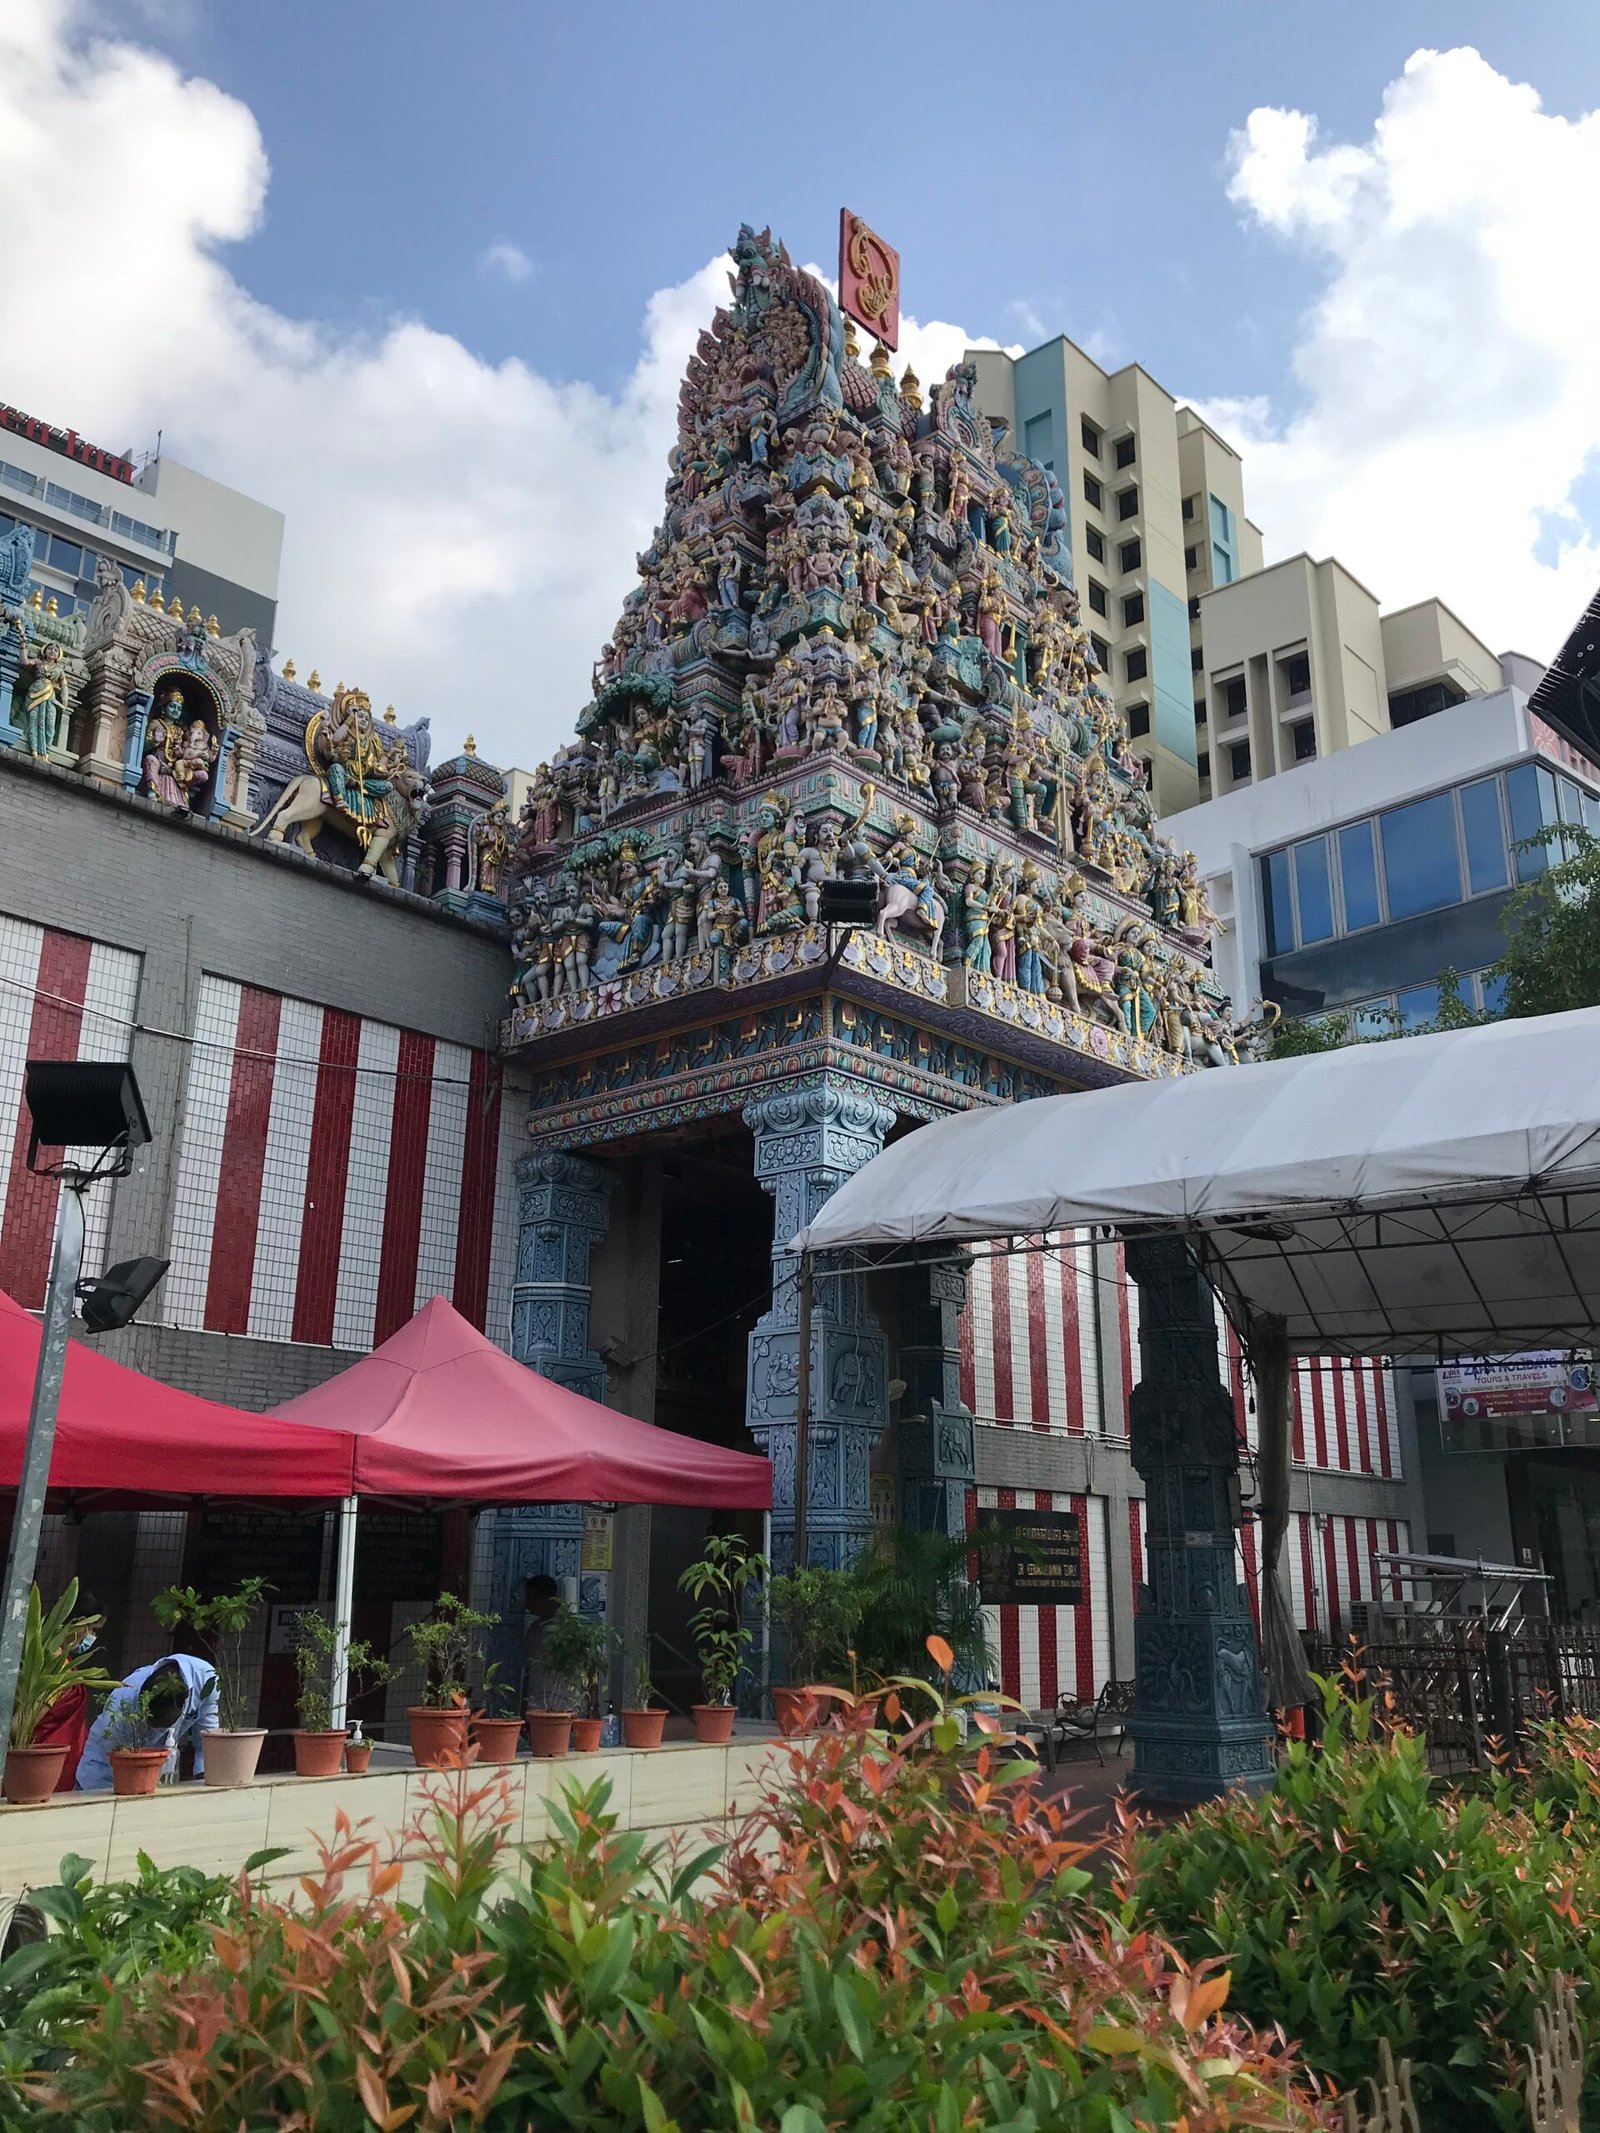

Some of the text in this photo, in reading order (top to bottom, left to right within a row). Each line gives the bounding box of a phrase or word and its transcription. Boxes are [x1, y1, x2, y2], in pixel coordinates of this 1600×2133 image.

[66, 428, 135, 487] Inn
[1476, 1376, 1503, 1384] TOURS
[1512, 1372, 1548, 1382] TRAVELS
